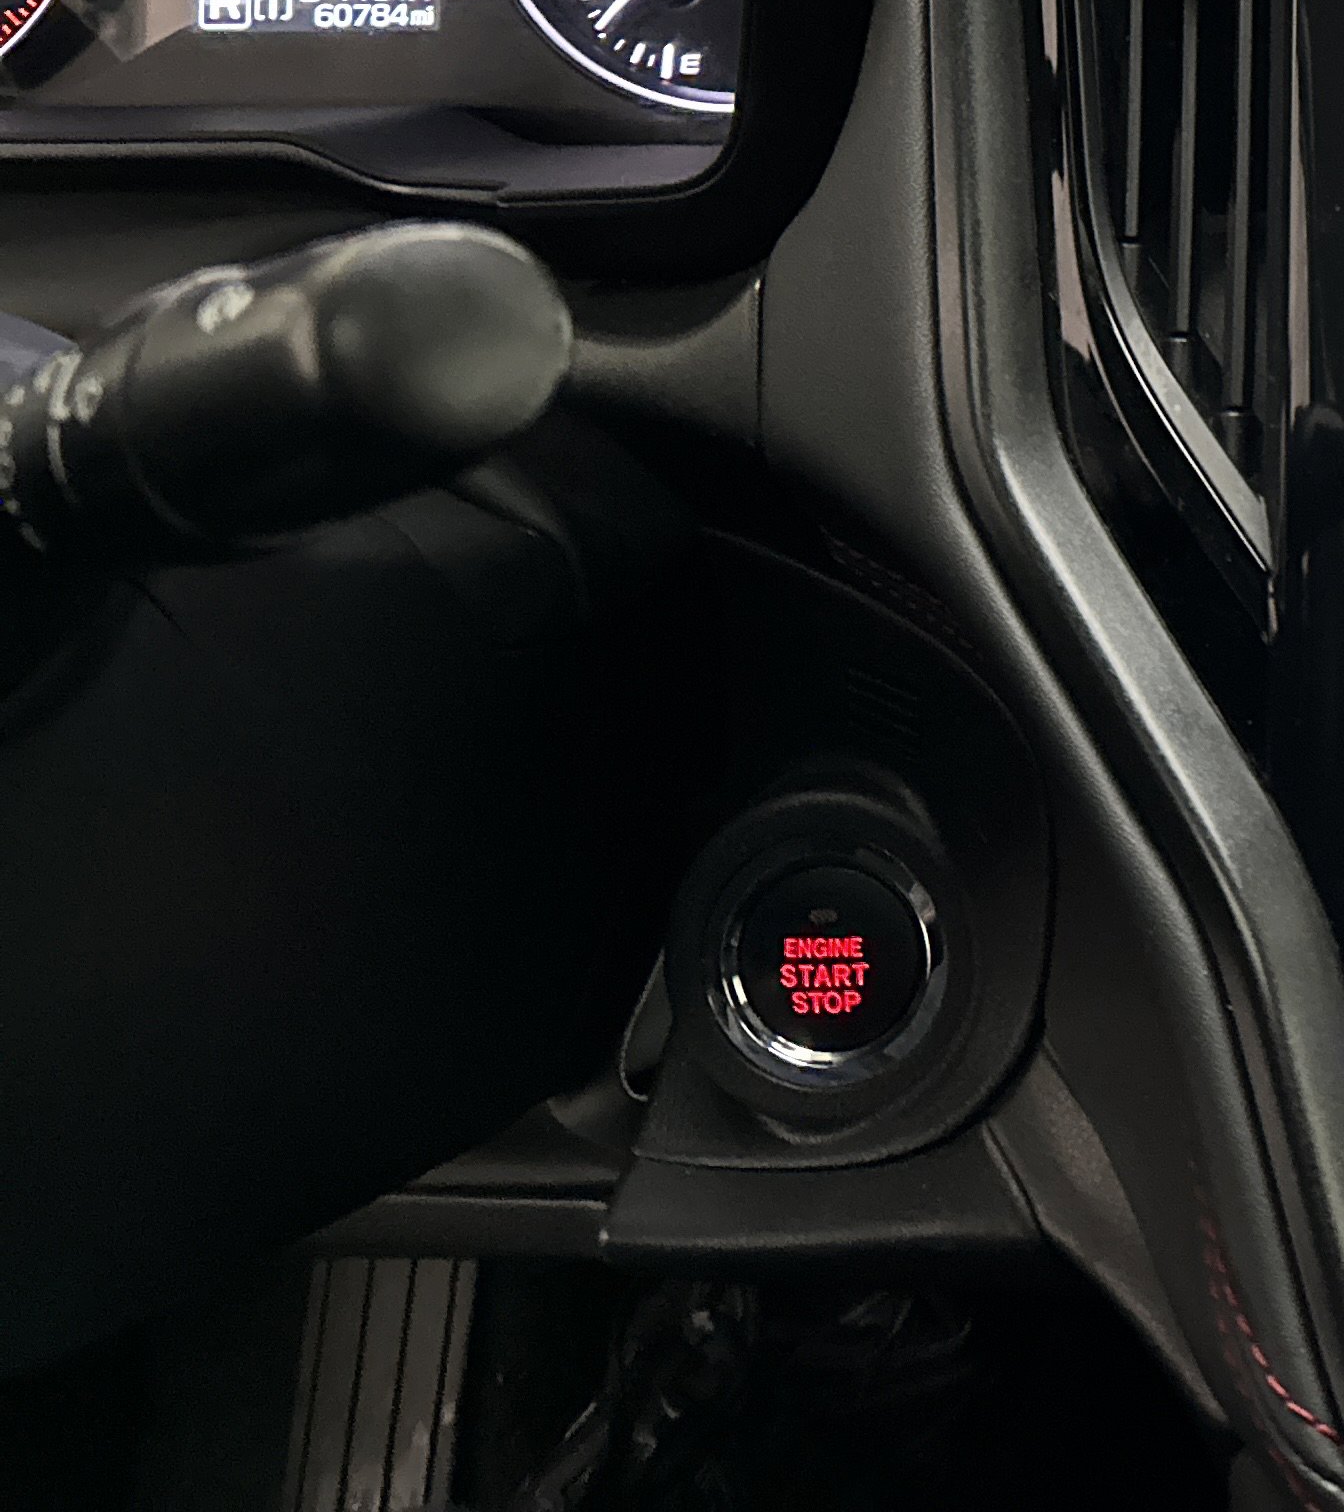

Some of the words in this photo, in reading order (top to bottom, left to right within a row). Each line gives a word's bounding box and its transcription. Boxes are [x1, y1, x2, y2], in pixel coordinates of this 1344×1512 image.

[679, 53, 702, 75] E
[783, 935, 864, 959] ENGINE
[779, 962, 869, 988] START
[791, 990, 862, 1014] STOP
